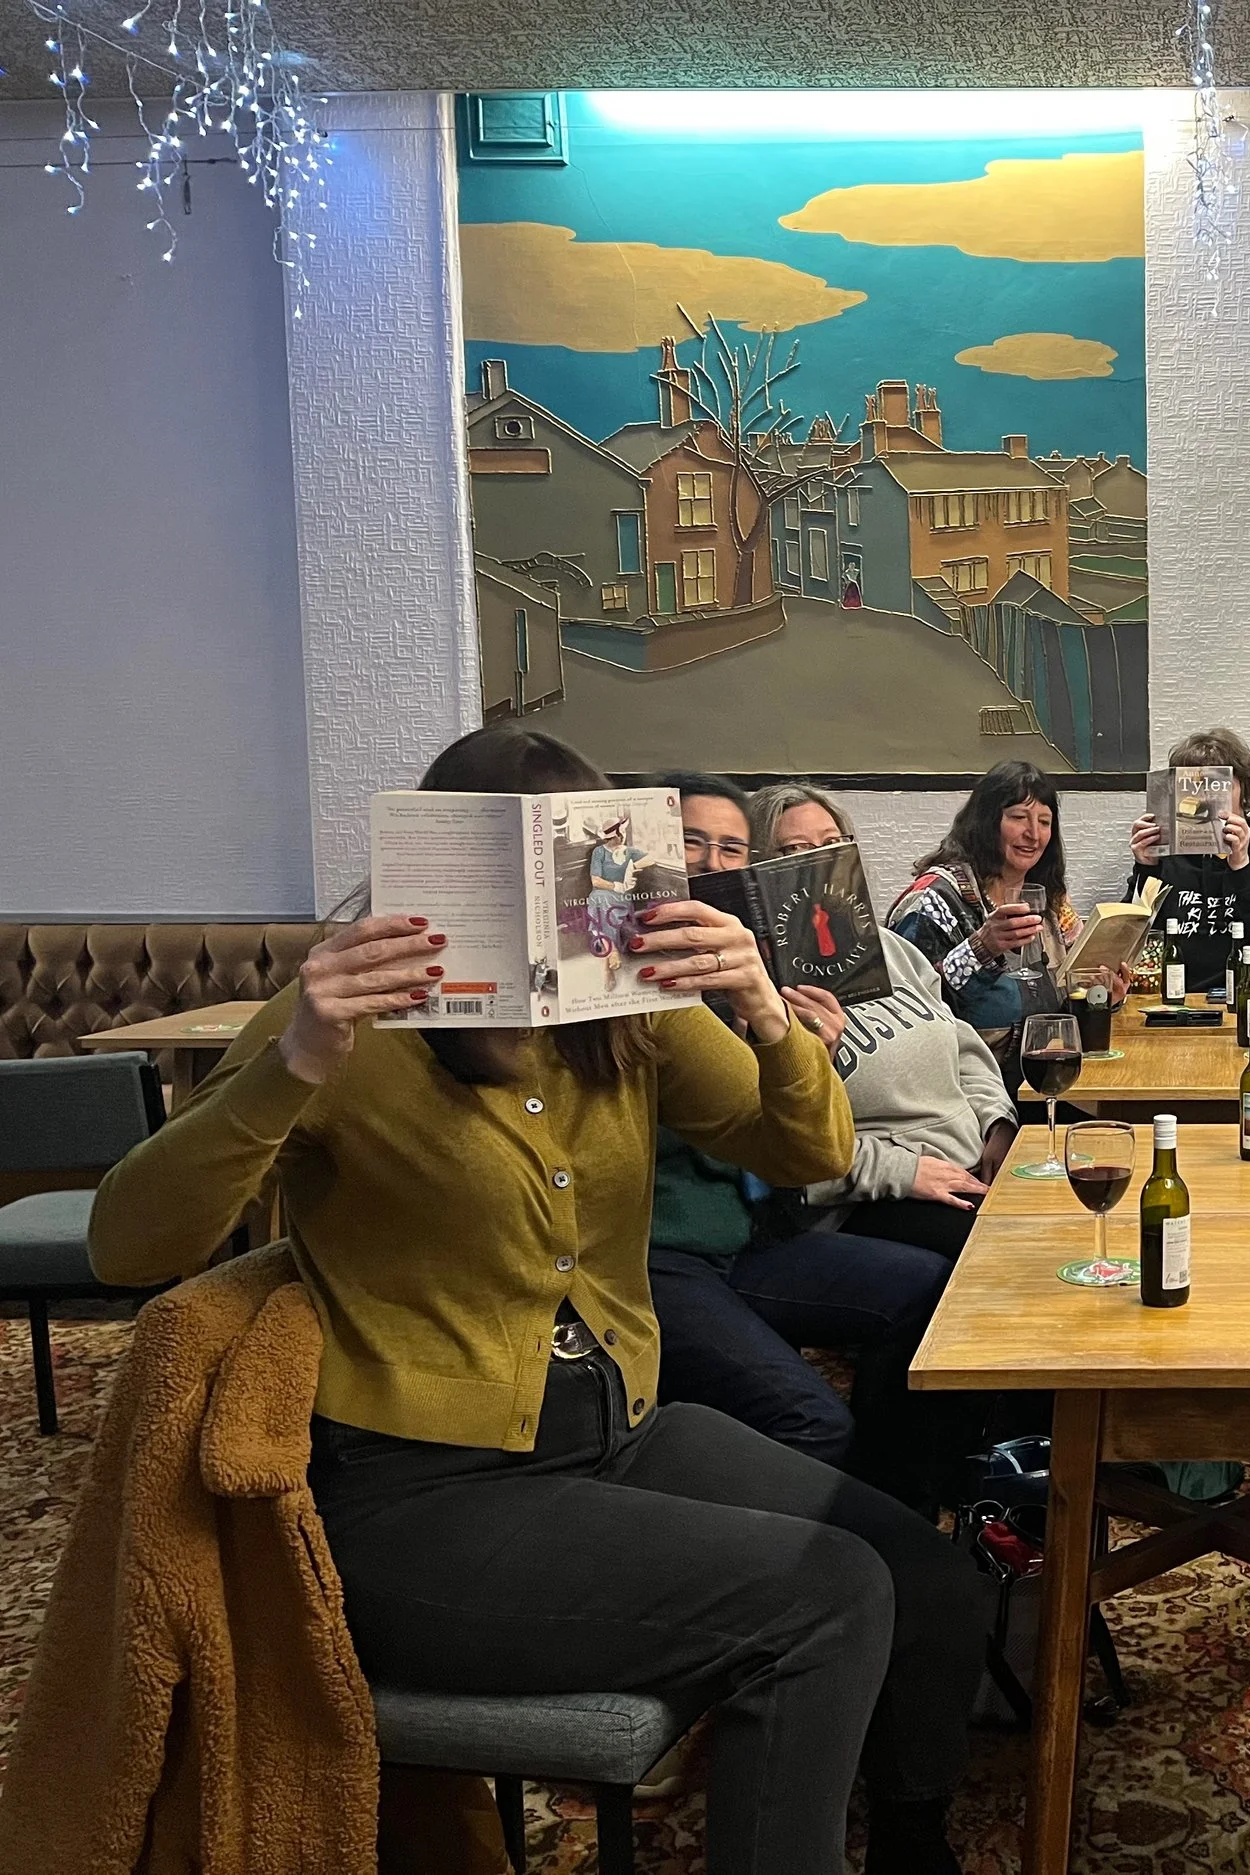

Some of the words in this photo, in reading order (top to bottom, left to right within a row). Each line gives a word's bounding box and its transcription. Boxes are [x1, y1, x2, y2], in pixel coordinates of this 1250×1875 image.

[1178, 776, 1232, 796] Tyler
[531, 803, 544, 856] SINGLED
[534, 859, 545, 888] OUT
[613, 889, 678, 903] NICHOLSON
[1178, 890, 1203, 907] THE
[775, 887, 811, 947] ROBERT
[823, 883, 872, 929] HARRIS
[792, 942, 868, 976] CONCLAVE
[836, 985, 942, 1083] BOSTO
